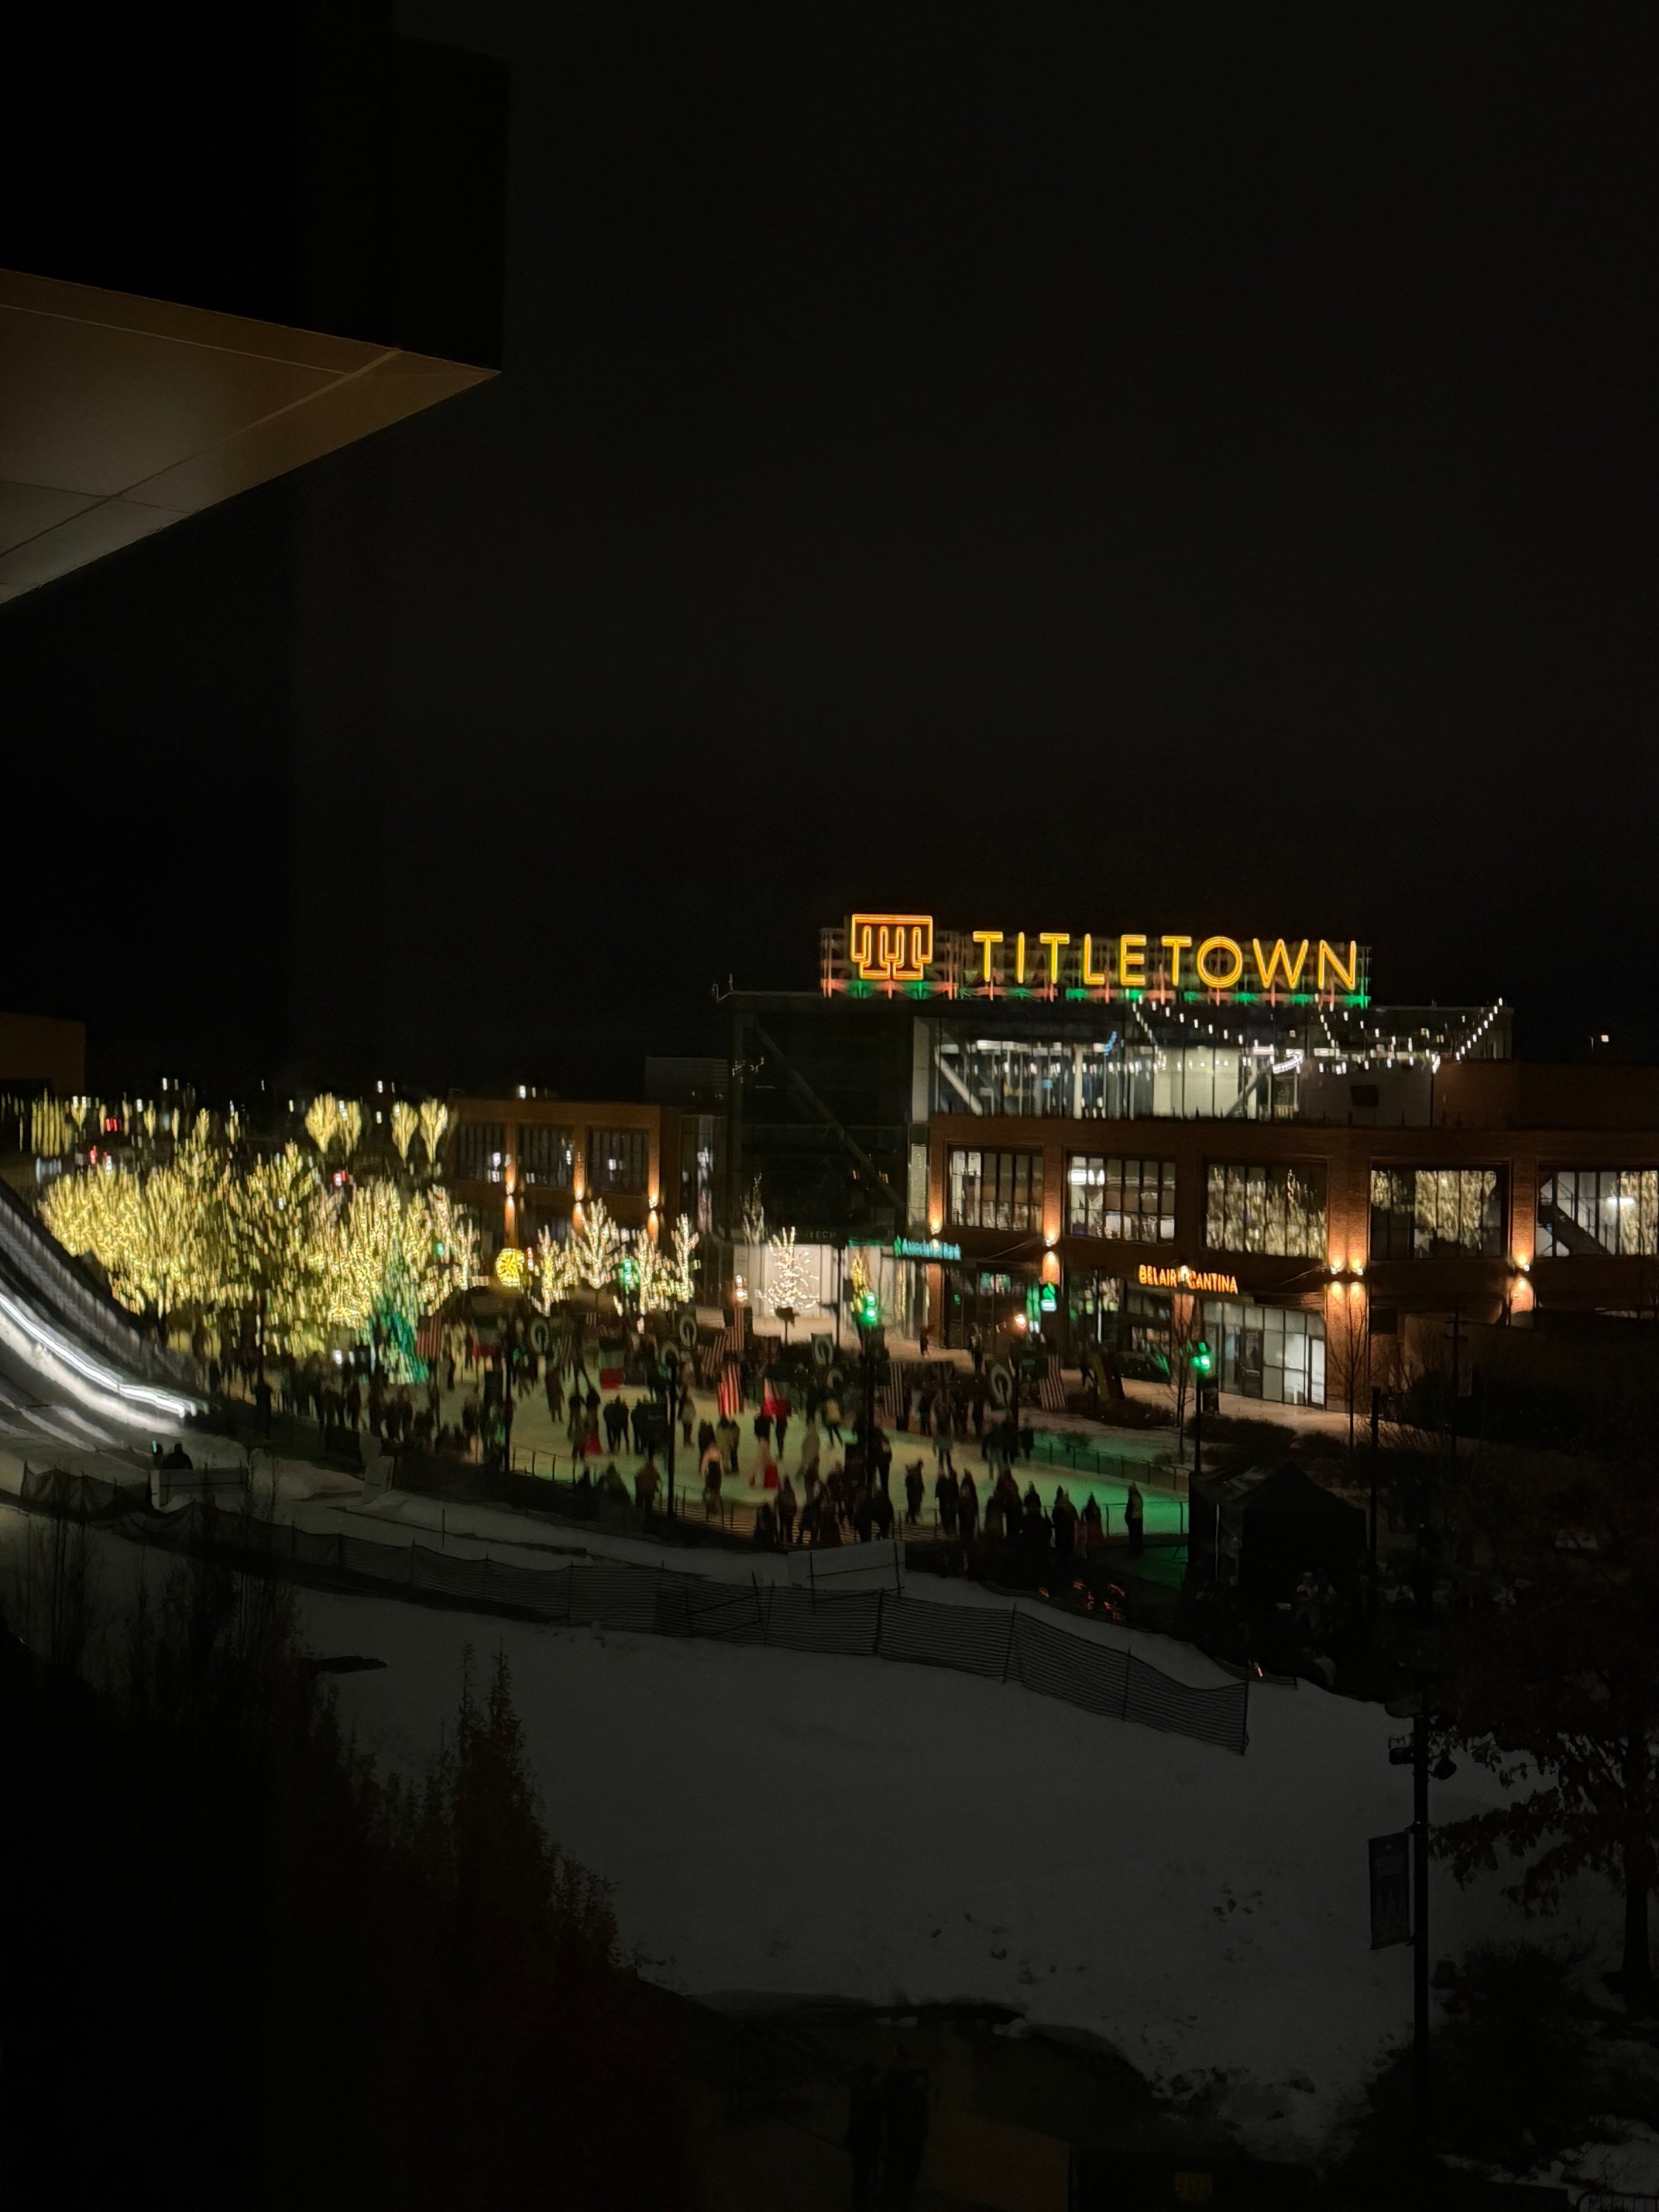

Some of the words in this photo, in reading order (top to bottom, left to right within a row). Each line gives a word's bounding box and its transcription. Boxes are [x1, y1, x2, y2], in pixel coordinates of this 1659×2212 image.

[973, 931, 1357, 990] TITLETOWN
[1139, 1264, 1178, 1288] BELAIR
[1187, 1270, 1238, 1295] CANTINA
